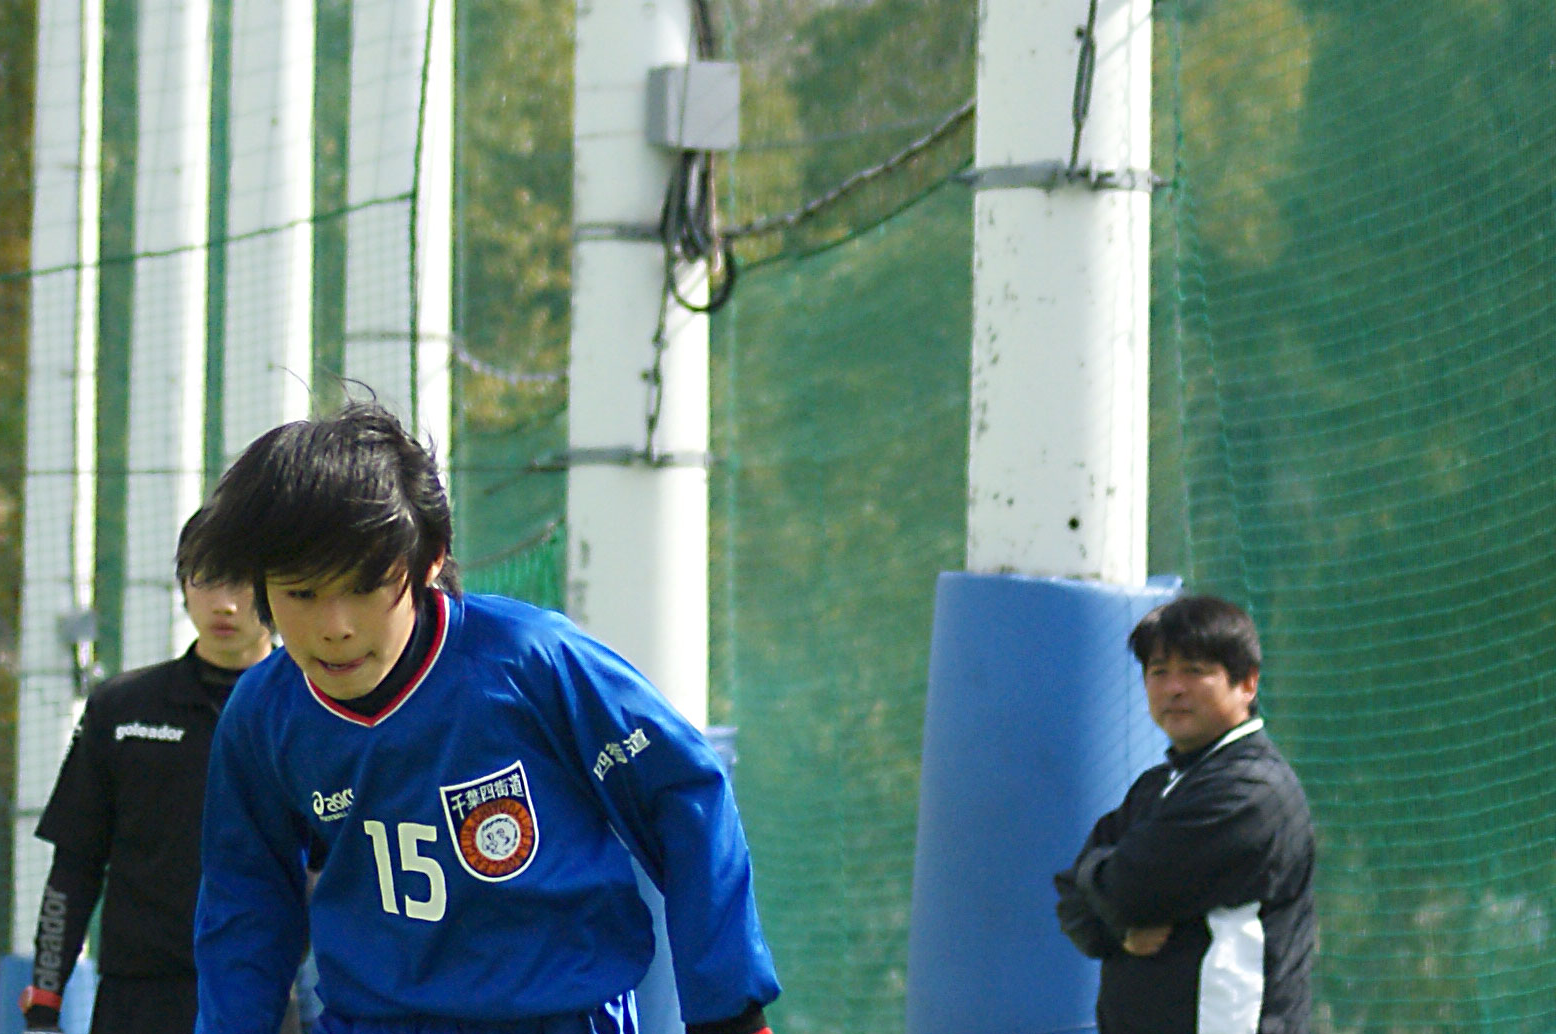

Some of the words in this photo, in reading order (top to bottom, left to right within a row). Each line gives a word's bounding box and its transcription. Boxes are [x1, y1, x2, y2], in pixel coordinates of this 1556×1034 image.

[115, 722, 185, 742] goleador
[449, 772, 525, 820] 千葉四街道
[363, 820, 448, 922] 15
[35, 885, 68, 992] oleador
